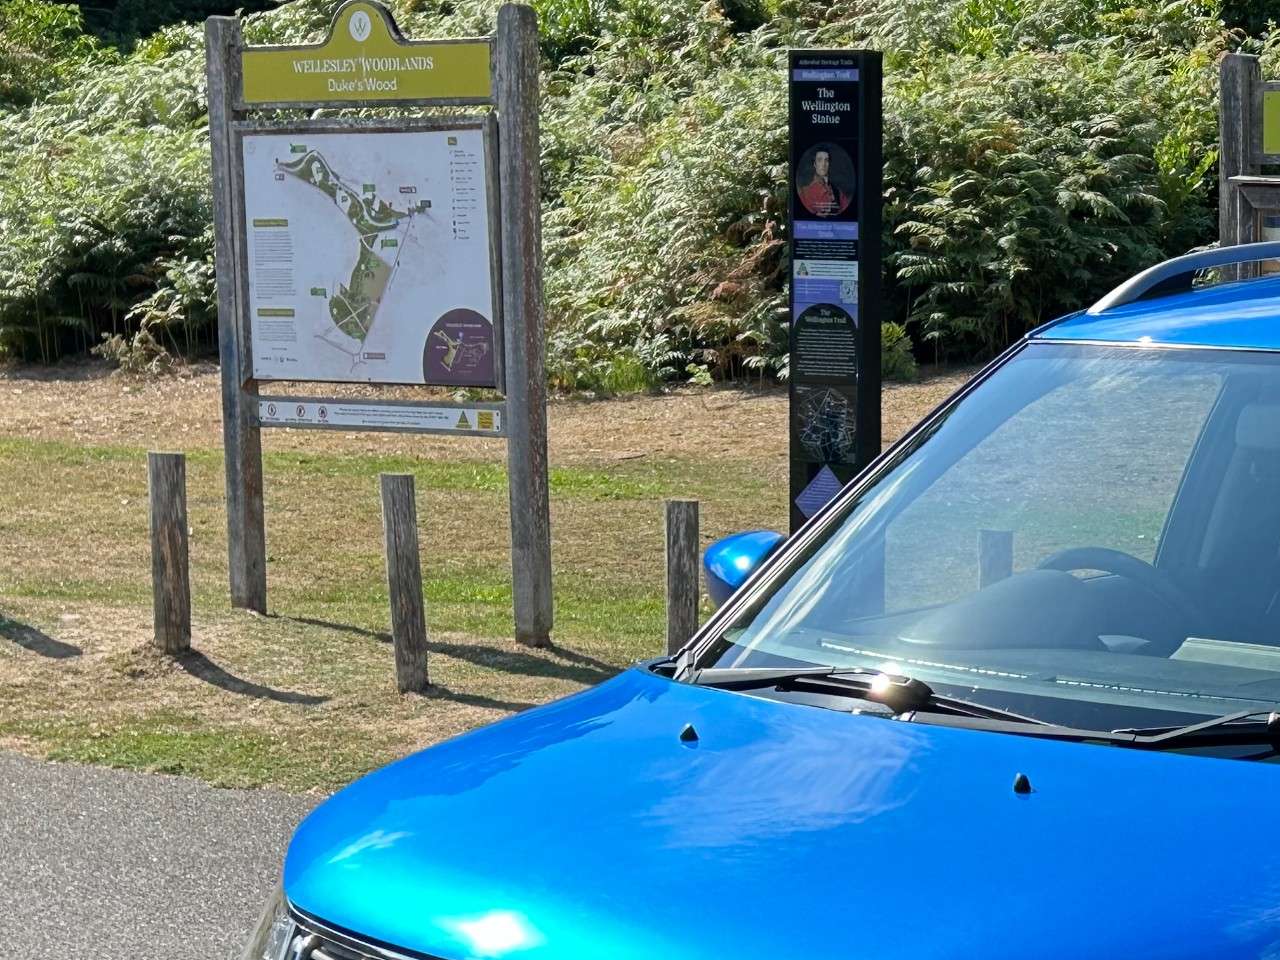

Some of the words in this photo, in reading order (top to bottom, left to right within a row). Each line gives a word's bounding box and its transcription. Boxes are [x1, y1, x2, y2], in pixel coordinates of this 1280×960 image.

[292, 59, 357, 73] WELLESLEY
[359, 56, 435, 72] WOODLANDS
[327, 78, 363, 92] Duke's
[364, 76, 398, 91] Wood
[816, 87, 835, 98] The
[801, 100, 851, 113] Wellington
[811, 113, 841, 124] Statue
